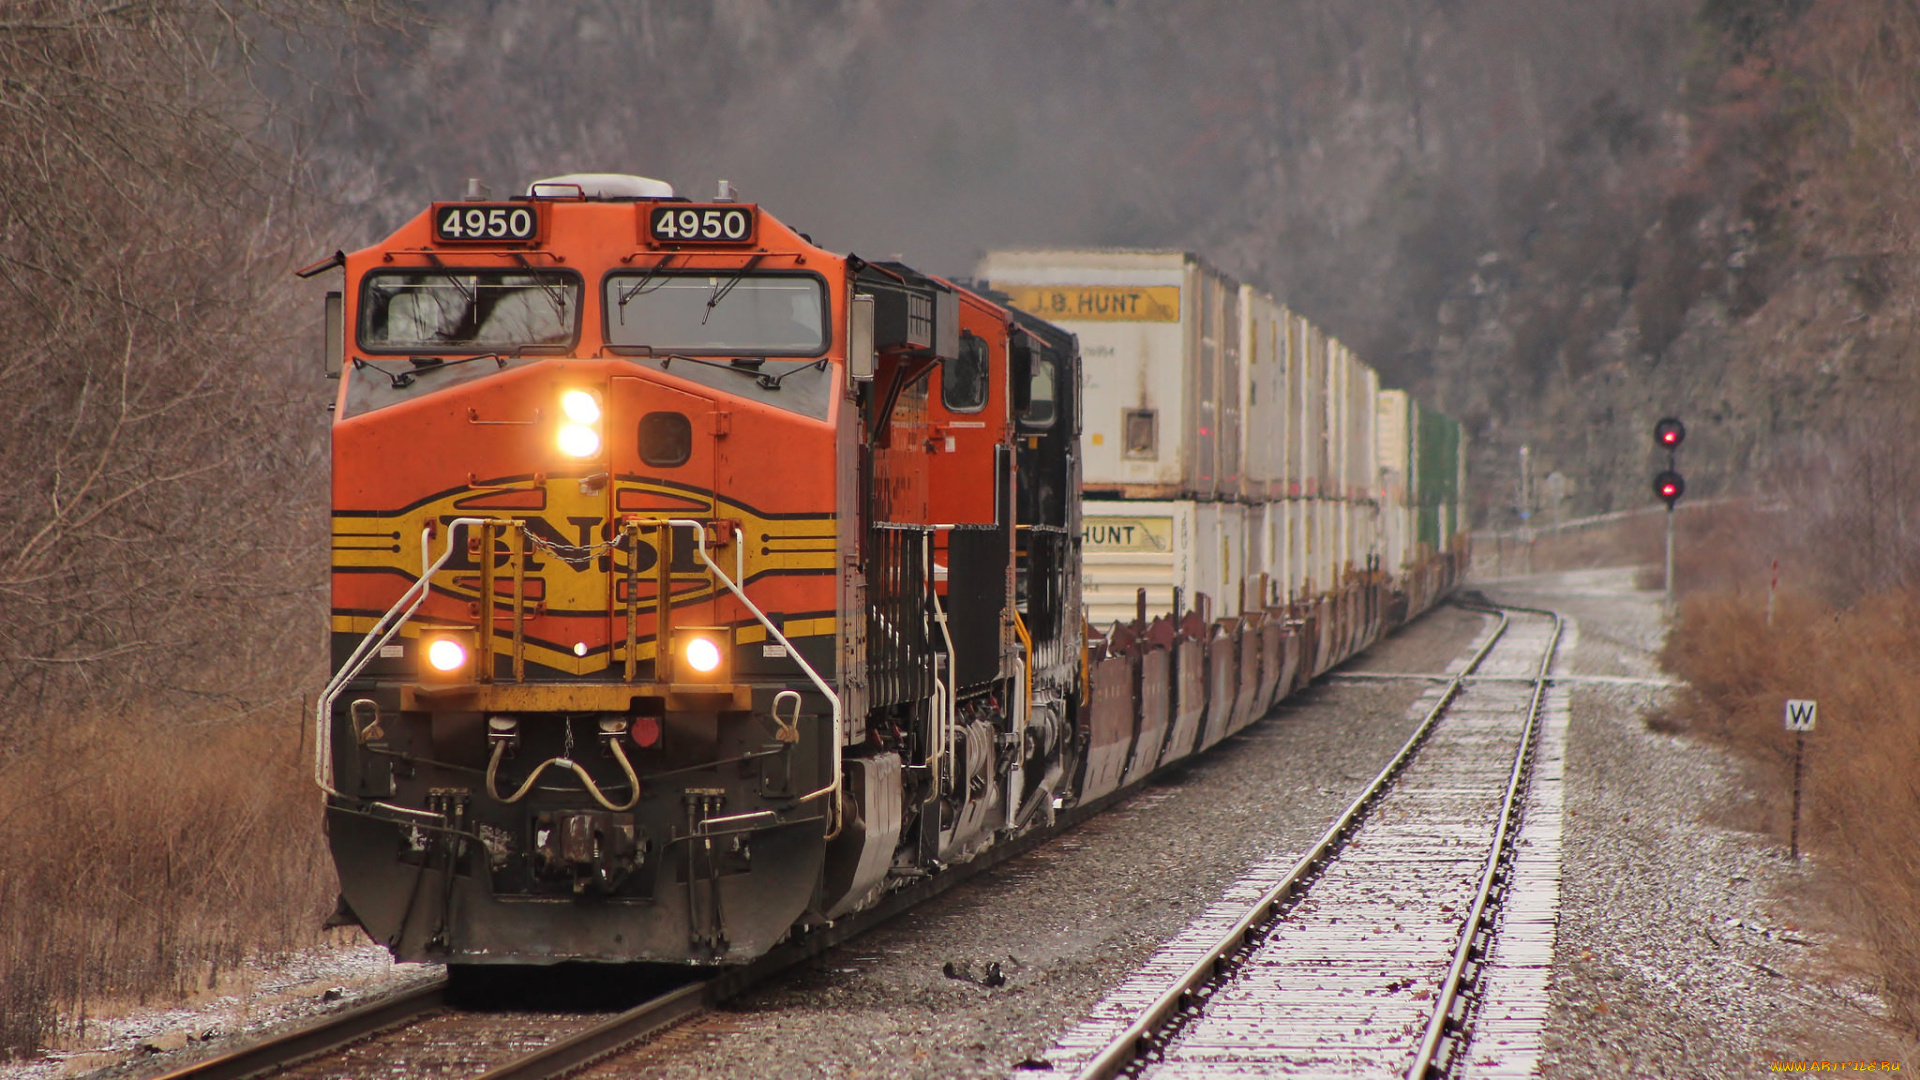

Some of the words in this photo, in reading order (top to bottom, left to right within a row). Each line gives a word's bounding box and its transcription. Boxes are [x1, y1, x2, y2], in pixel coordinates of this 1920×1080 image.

[442, 208, 531, 238] 4950
[656, 210, 745, 239] 4950
[1078, 293, 1142, 313] HUNT
[439, 515, 720, 573] BNSF
[1790, 702, 1814, 725] W
